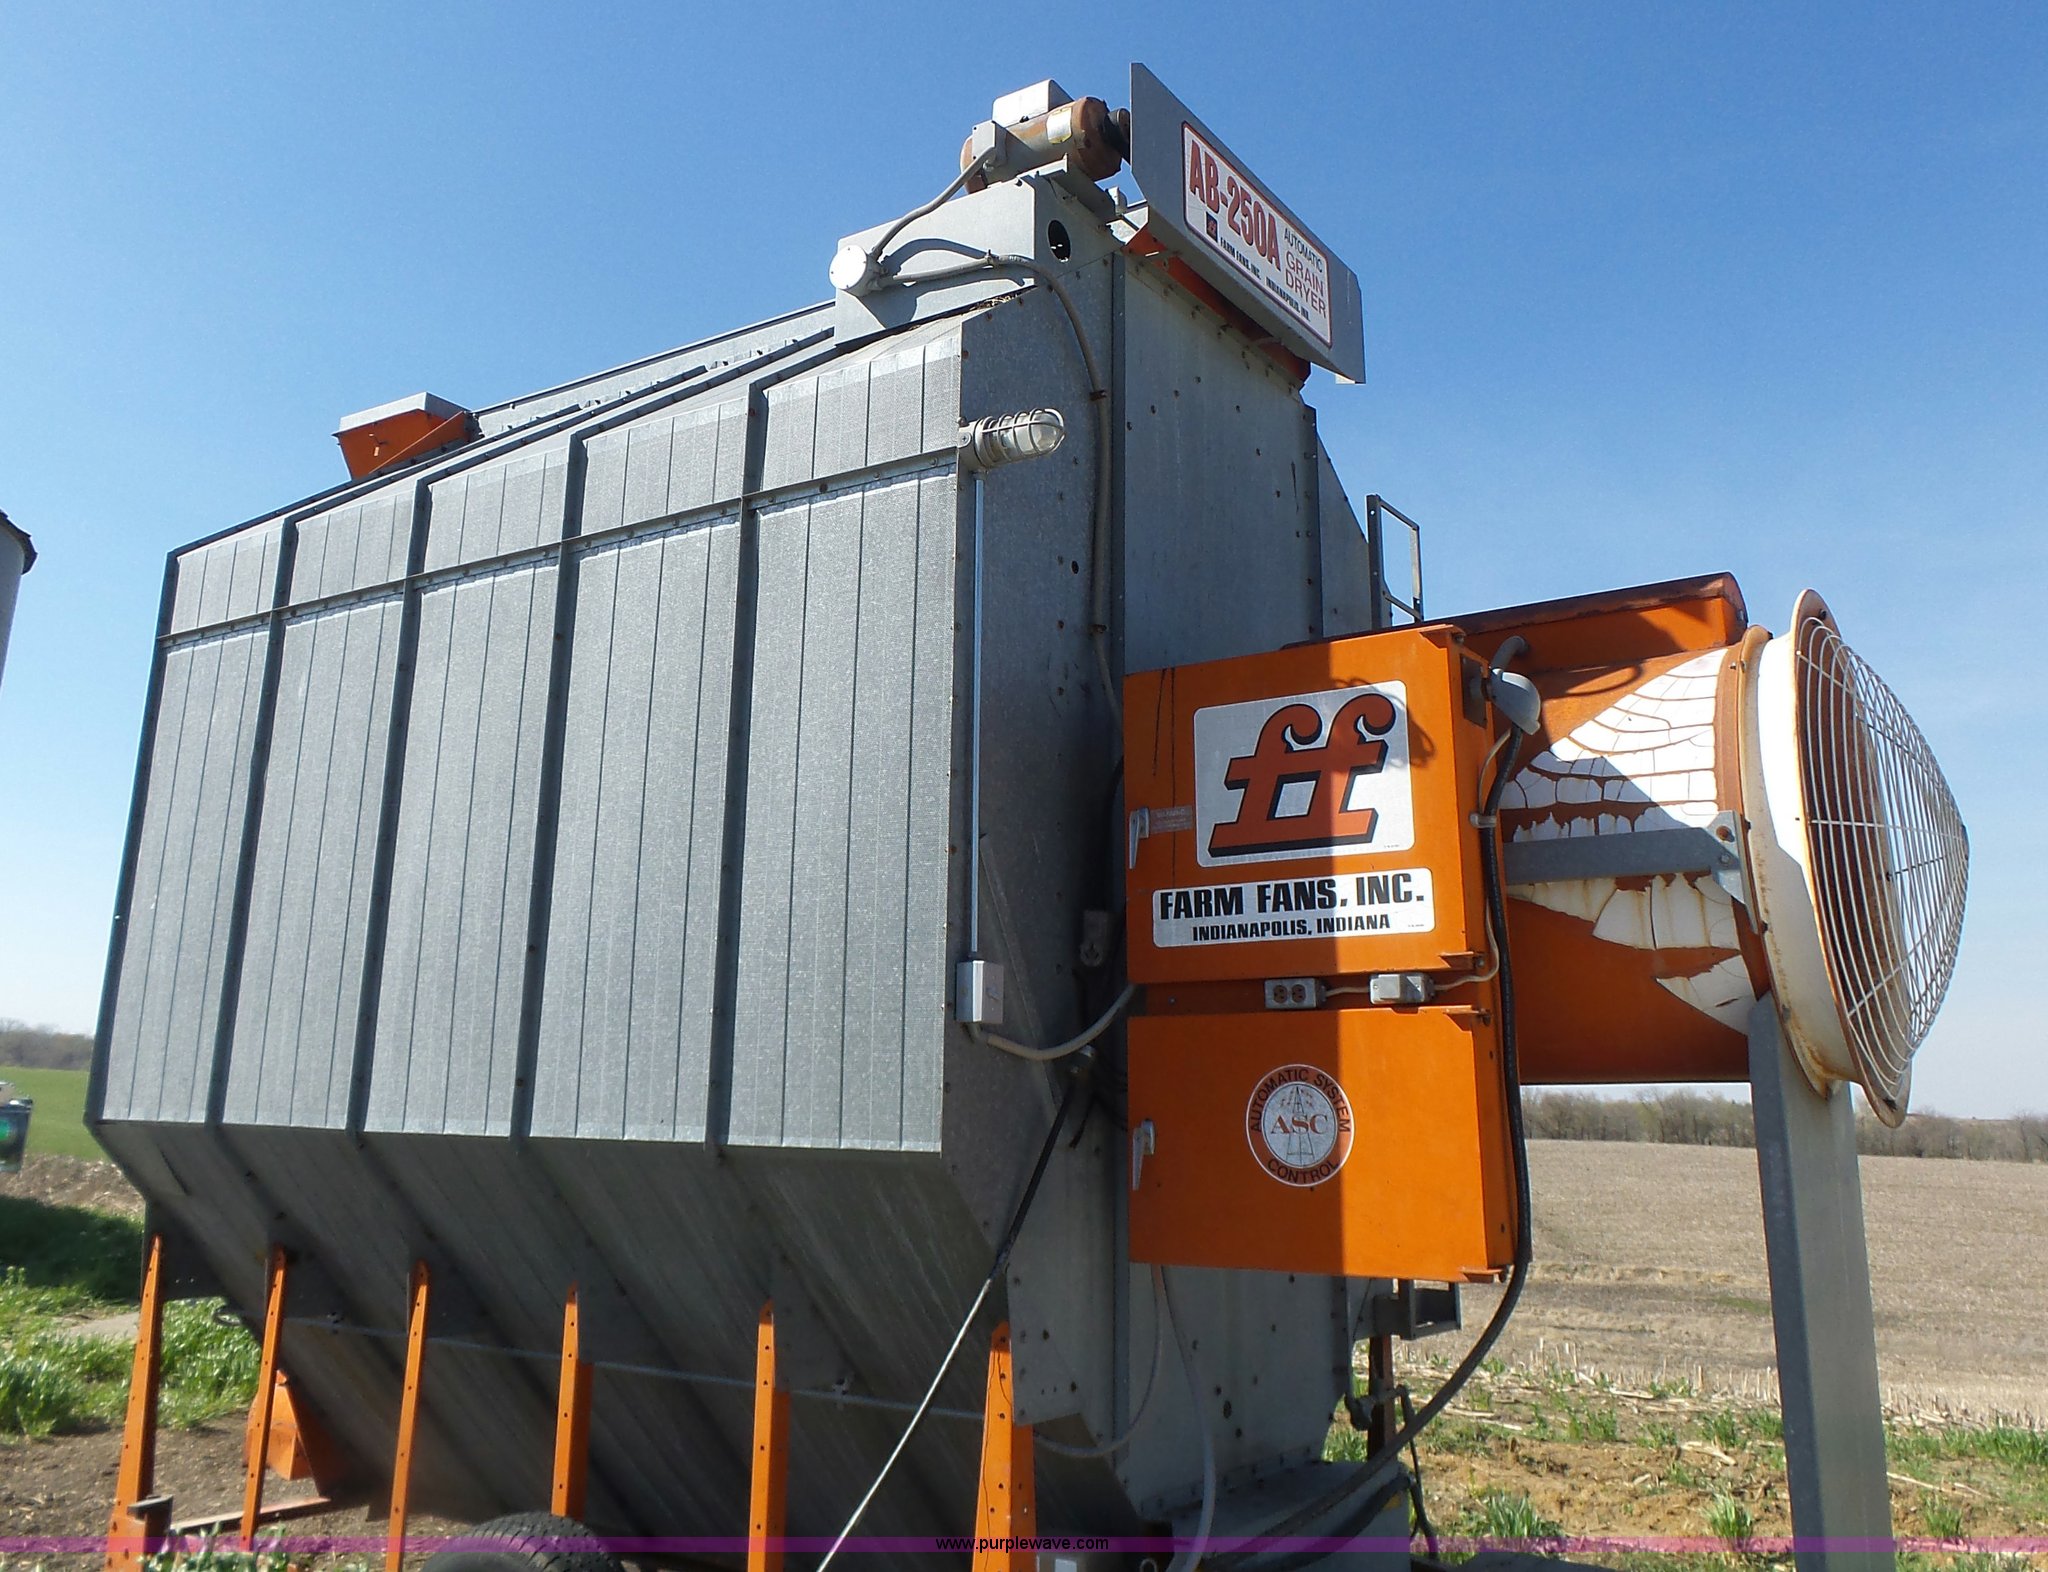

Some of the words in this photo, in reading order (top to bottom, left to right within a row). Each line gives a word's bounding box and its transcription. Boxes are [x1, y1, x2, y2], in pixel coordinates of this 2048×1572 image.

[1190, 139, 1281, 272] AB-250A
[1284, 228, 1323, 273] AUTOMATIC
[1286, 250, 1324, 297] GRAIN
[1285, 269, 1327, 319] DRYER
[1160, 886, 1244, 920] FARM
[1257, 879, 1348, 914] FANS,
[1356, 873, 1425, 906] INC.
[1192, 919, 1312, 942] INDIANAPOLIS,
[1317, 914, 1390, 935] INDIANA
[1251, 1068, 1309, 1133] AUTOMATIC
[1314, 1073, 1351, 1133] SYSTEM
[1270, 1113, 1328, 1135] ASC
[1267, 1158, 1339, 1184] CONTROL
